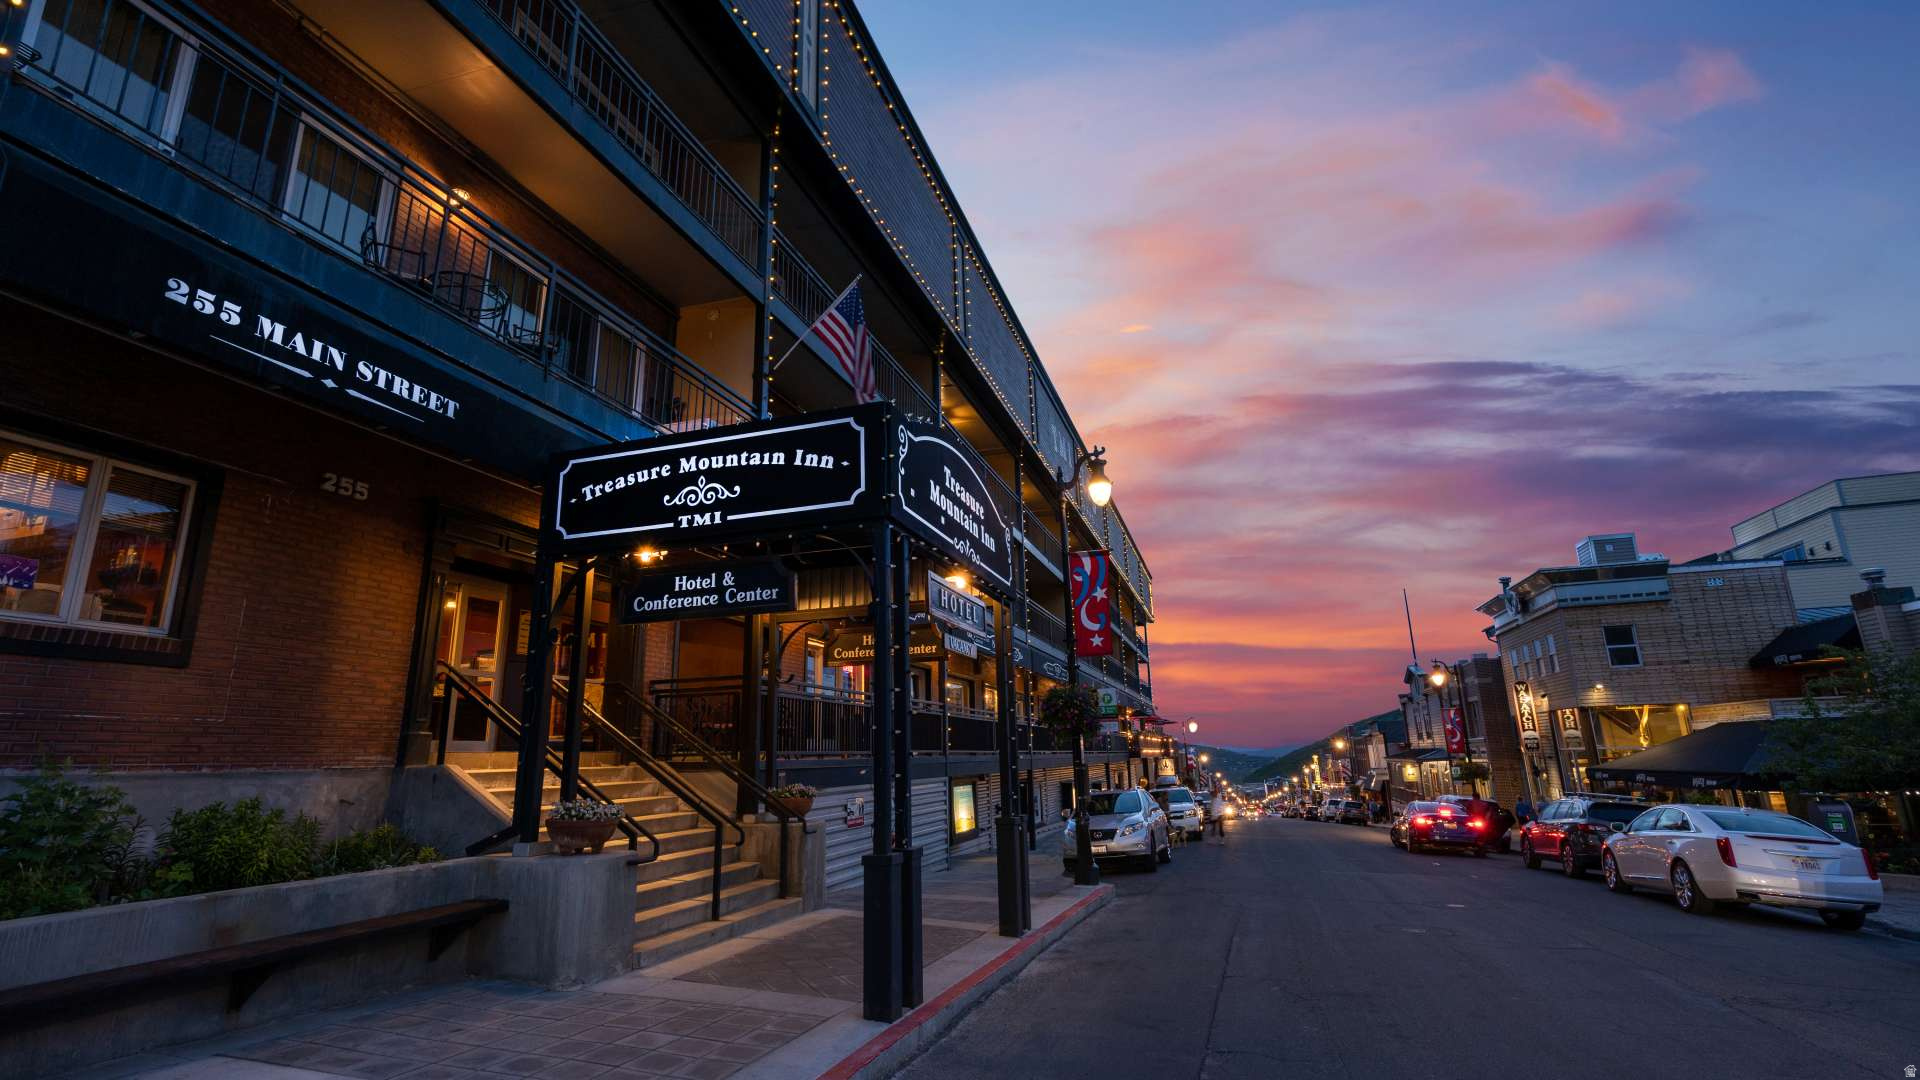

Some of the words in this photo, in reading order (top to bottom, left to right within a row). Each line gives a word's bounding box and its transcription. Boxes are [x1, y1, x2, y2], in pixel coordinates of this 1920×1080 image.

[164, 278, 242, 326] 255
[254, 315, 347, 372] MAIN
[356, 360, 460, 420] STREET
[321, 473, 369, 500] 255
[582, 460, 671, 502] Treasure
[679, 449, 785, 473] Mountain
[793, 449, 834, 470] Inn
[944, 465, 985, 520] Treasure
[679, 511, 722, 529] TMI
[929, 479, 979, 539] Mountain
[980, 524, 996, 553] Inn
[633, 591, 718, 613] Conference
[725, 586, 778, 605] Center
[674, 574, 717, 592] Hotel
[722, 572, 735, 586] &
[940, 588, 978, 623] HOTEL
[834, 646, 894, 659] Confere
[908, 644, 937, 655] enter
[1515, 683, 1534, 730] WASATCH
